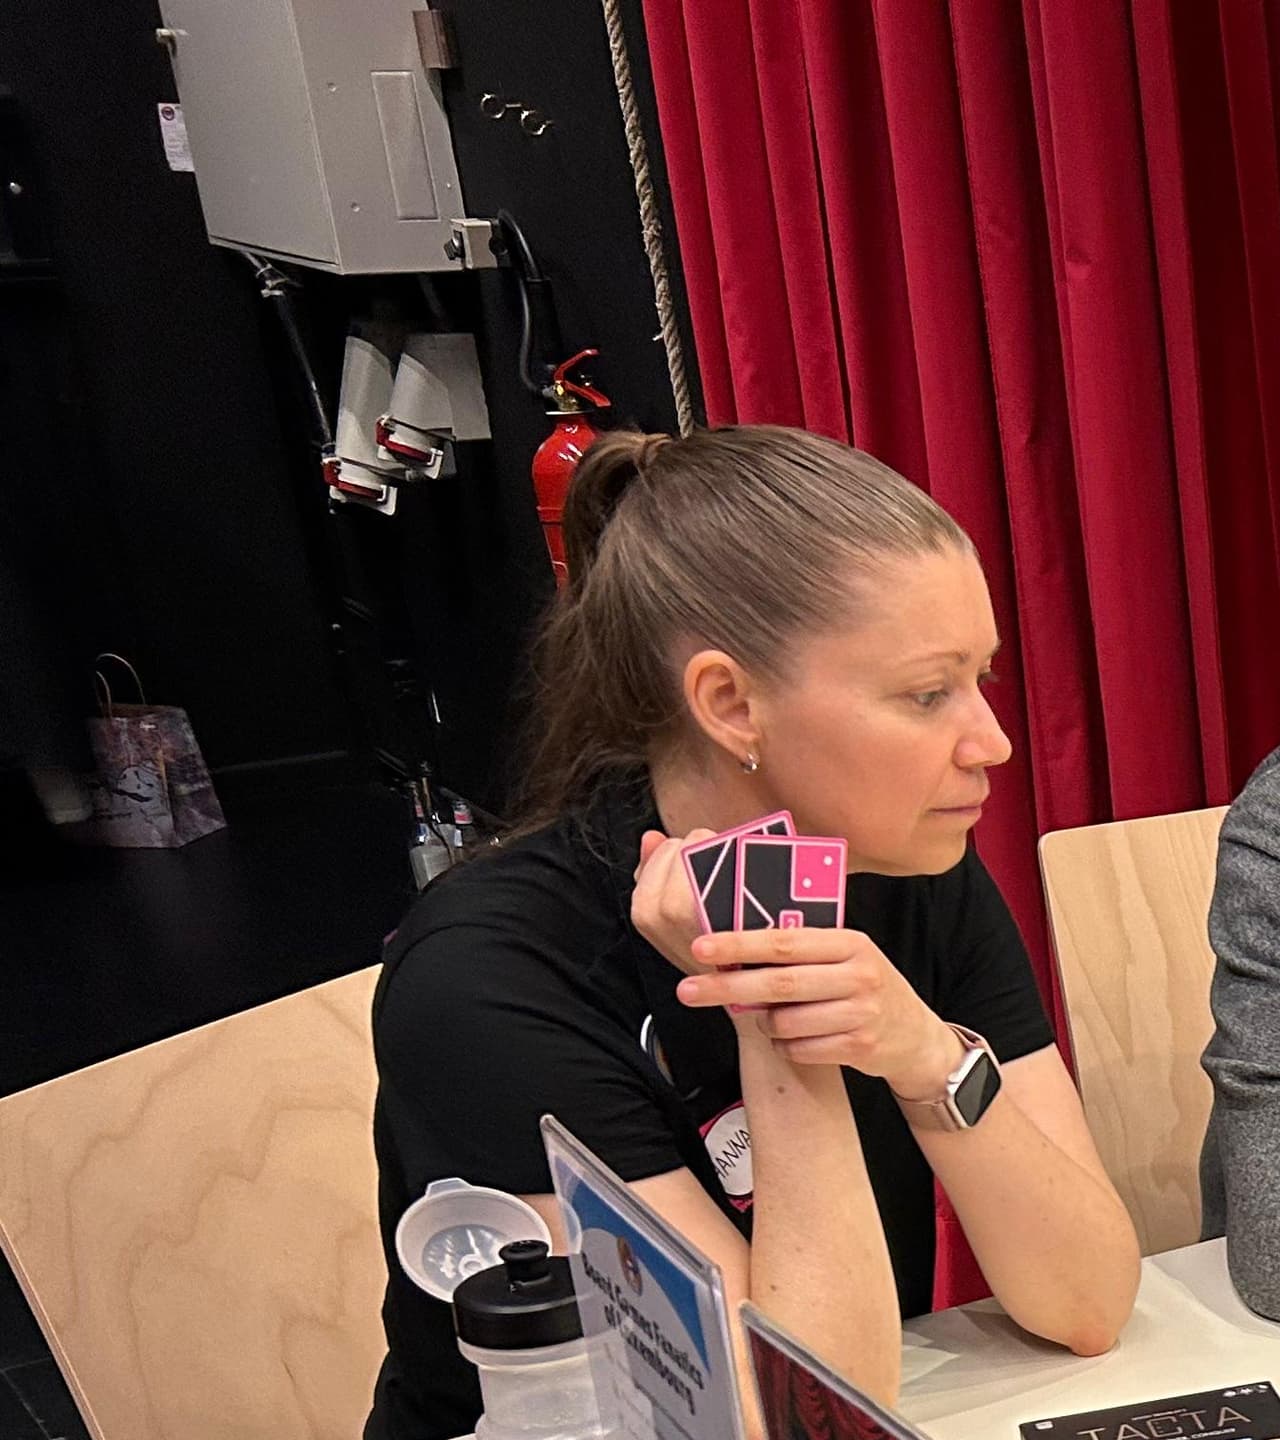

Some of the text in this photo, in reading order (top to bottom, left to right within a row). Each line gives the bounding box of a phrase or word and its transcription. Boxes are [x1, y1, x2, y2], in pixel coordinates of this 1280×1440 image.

[581, 1252, 704, 1390] Board Games Fanatics
